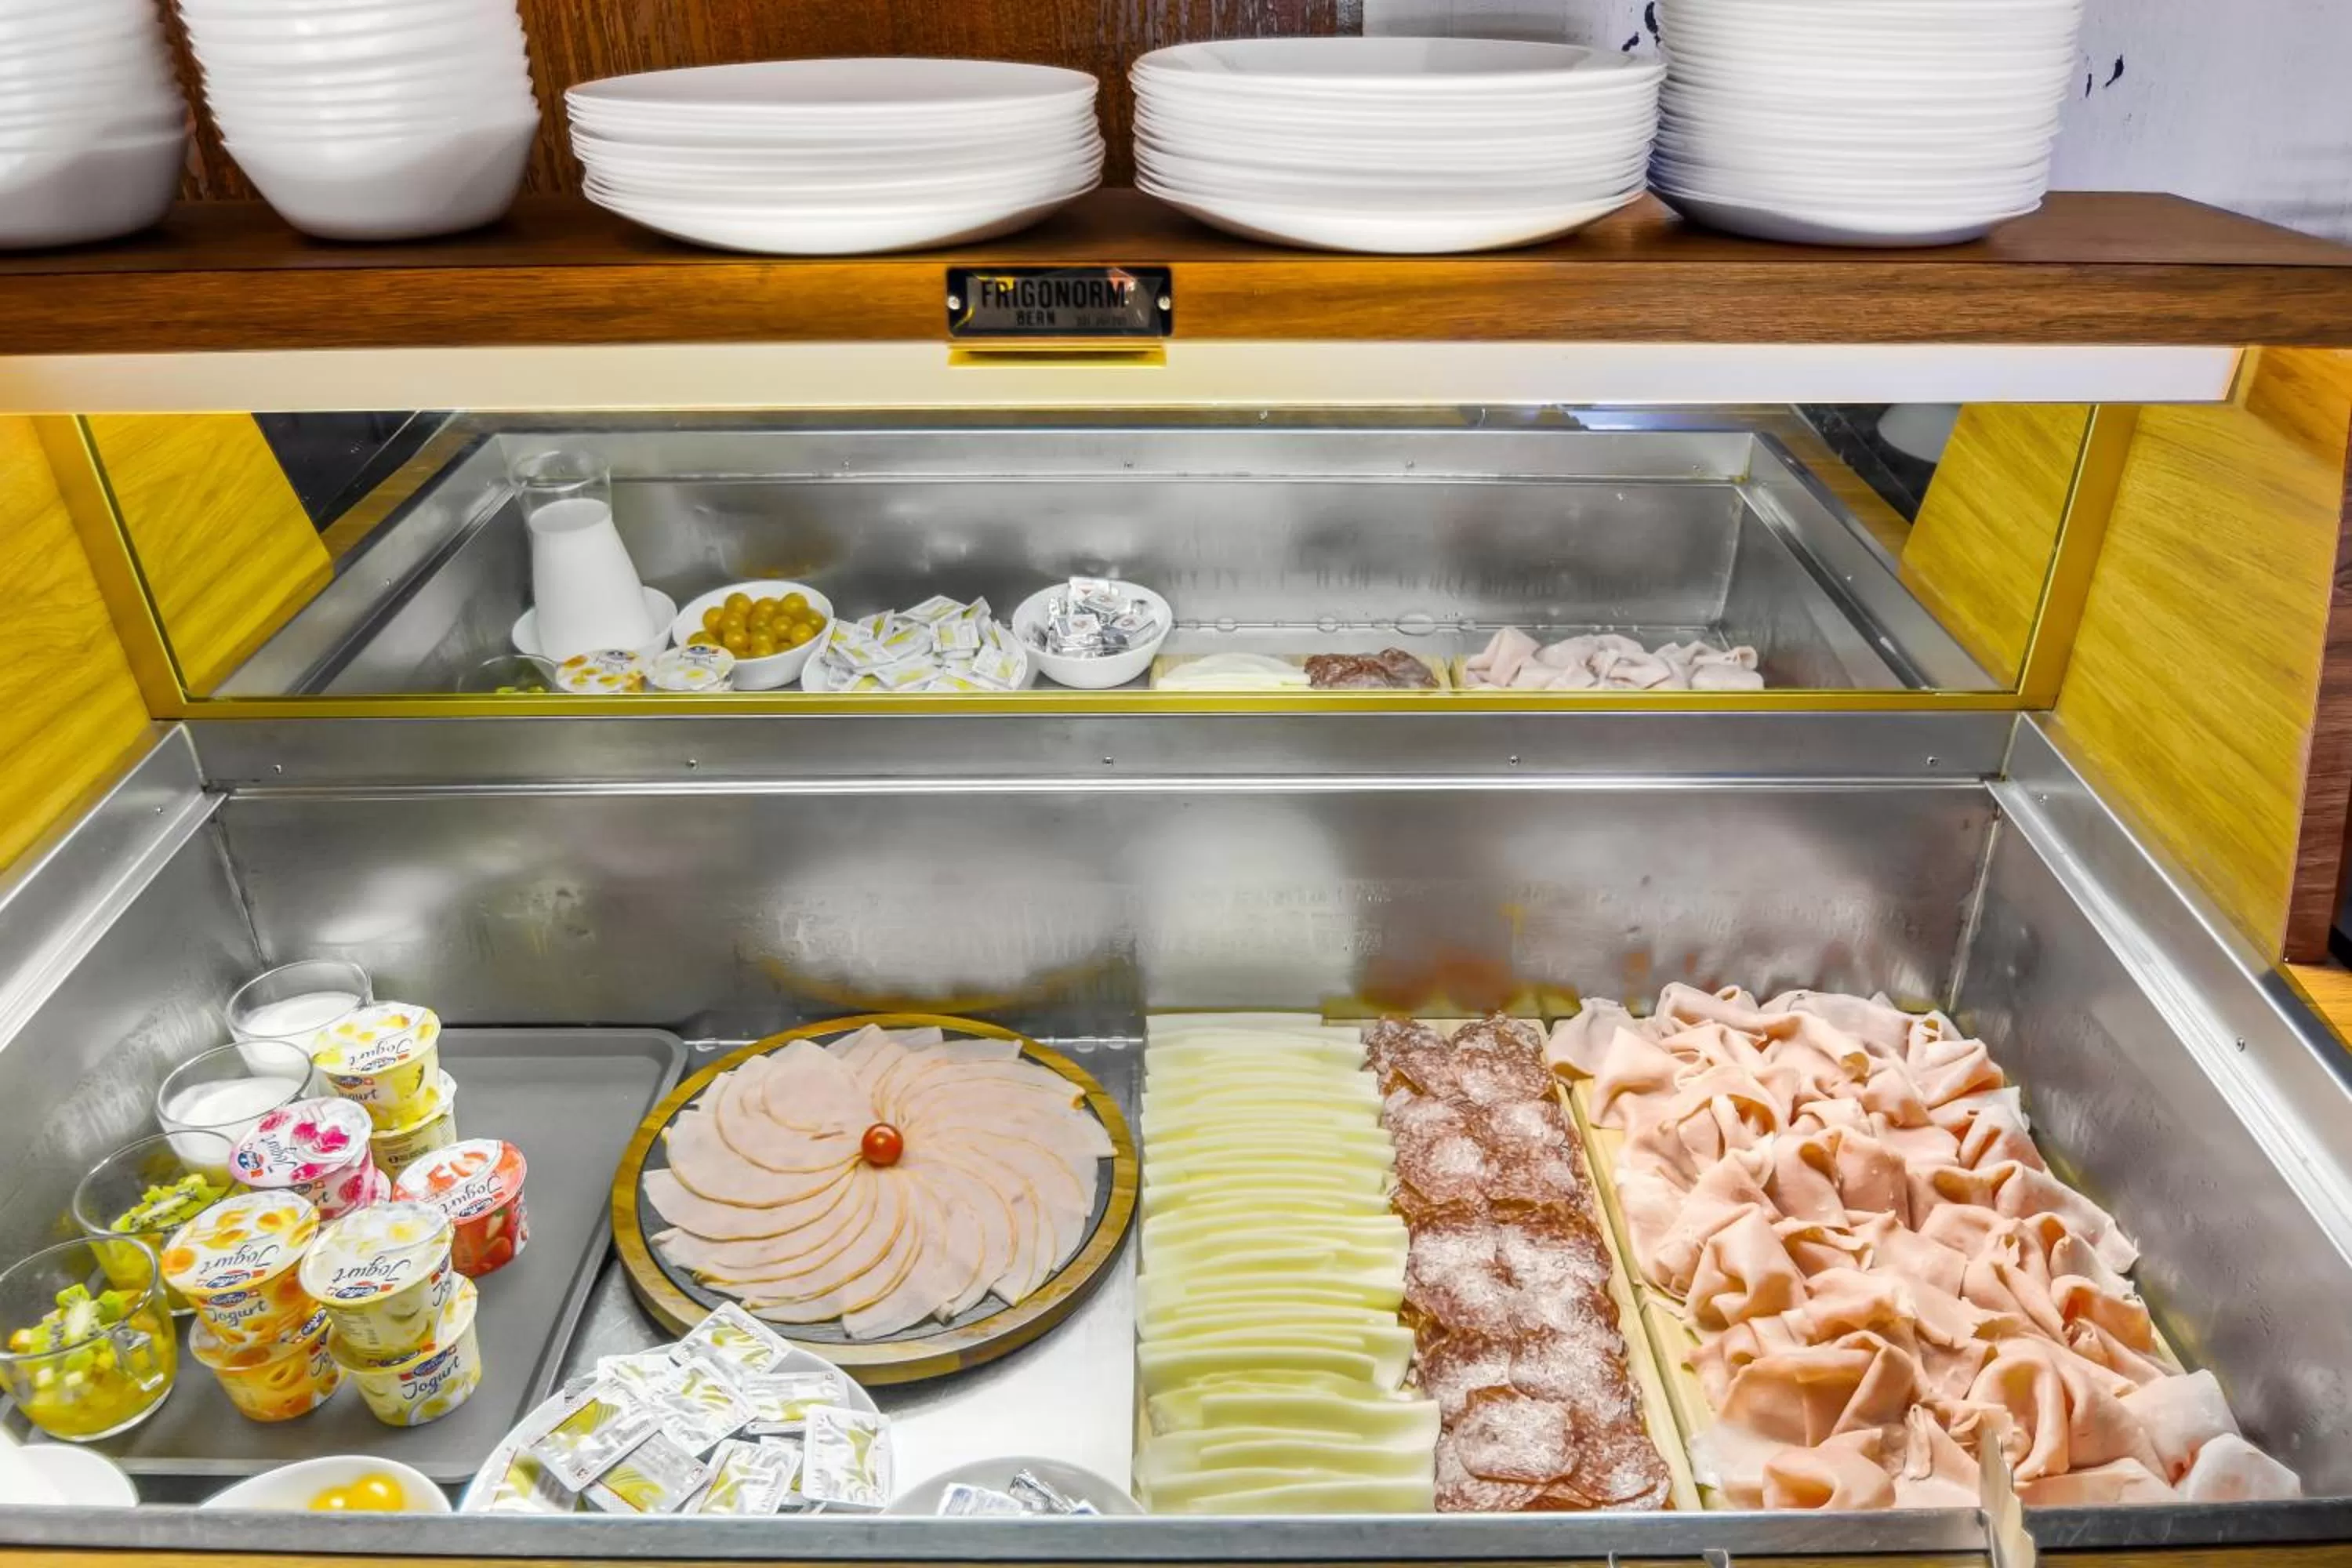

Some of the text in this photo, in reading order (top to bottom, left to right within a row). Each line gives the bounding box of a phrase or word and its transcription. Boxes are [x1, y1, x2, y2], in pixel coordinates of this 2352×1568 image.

[982, 280, 1126, 308] FRIGONORM
[1017, 310, 1057, 326] BERN
[439, 1174, 503, 1215] Jogurt
[200, 1244, 280, 1275] Jogurt
[332, 1255, 411, 1283] Jogurt
[209, 1300, 267, 1327] Jogurt
[401, 1356, 459, 1399] Jogurt
